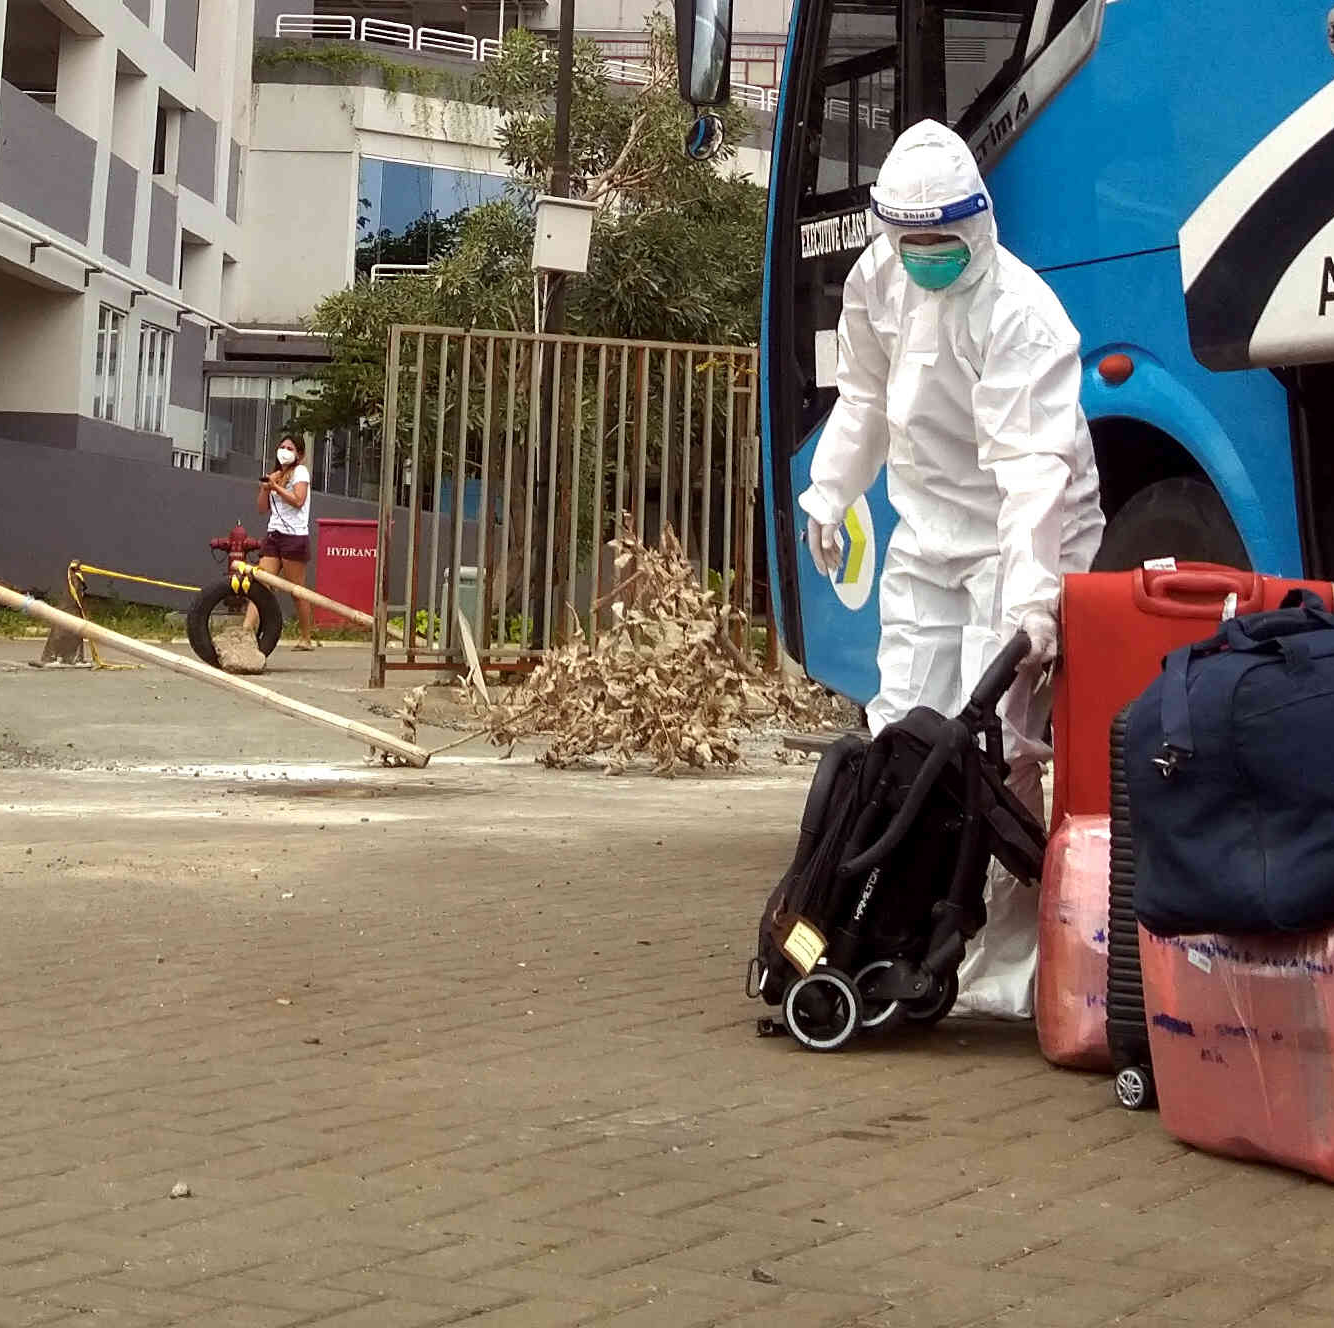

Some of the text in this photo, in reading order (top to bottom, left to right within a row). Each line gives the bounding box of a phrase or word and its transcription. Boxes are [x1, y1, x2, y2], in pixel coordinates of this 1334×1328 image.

[800, 211, 866, 259] EXECUTIVE CLASS
[326, 546, 377, 558] HYDRANT
